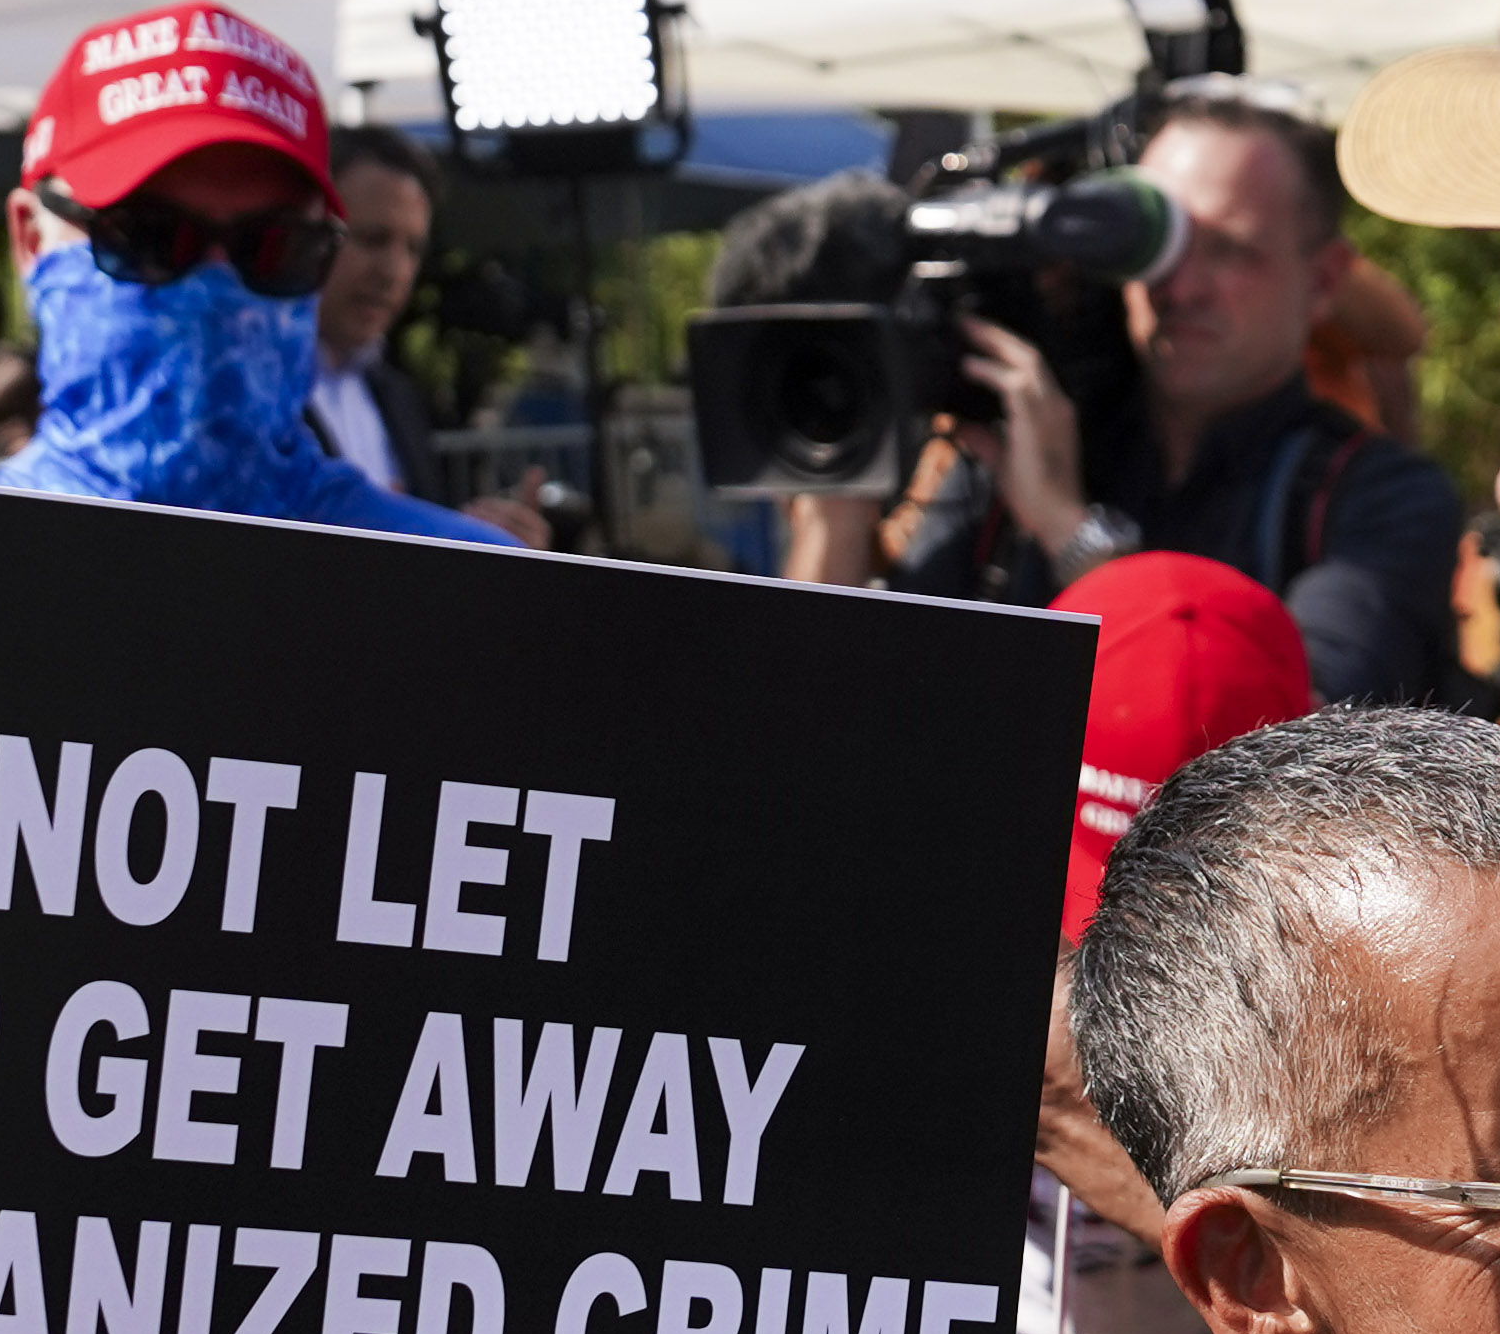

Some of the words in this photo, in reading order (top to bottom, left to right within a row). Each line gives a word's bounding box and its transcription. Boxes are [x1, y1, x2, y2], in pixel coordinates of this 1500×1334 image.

[82, 16, 180, 76] MAKE
[184, 10, 317, 98] AMERICA
[98, 64, 211, 126] GREAT
[217, 69, 308, 141] AGAIN
[337, 772, 615, 962] LET
[46, 981, 349, 1169] GET
[376, 1012, 805, 1205] AWAY
